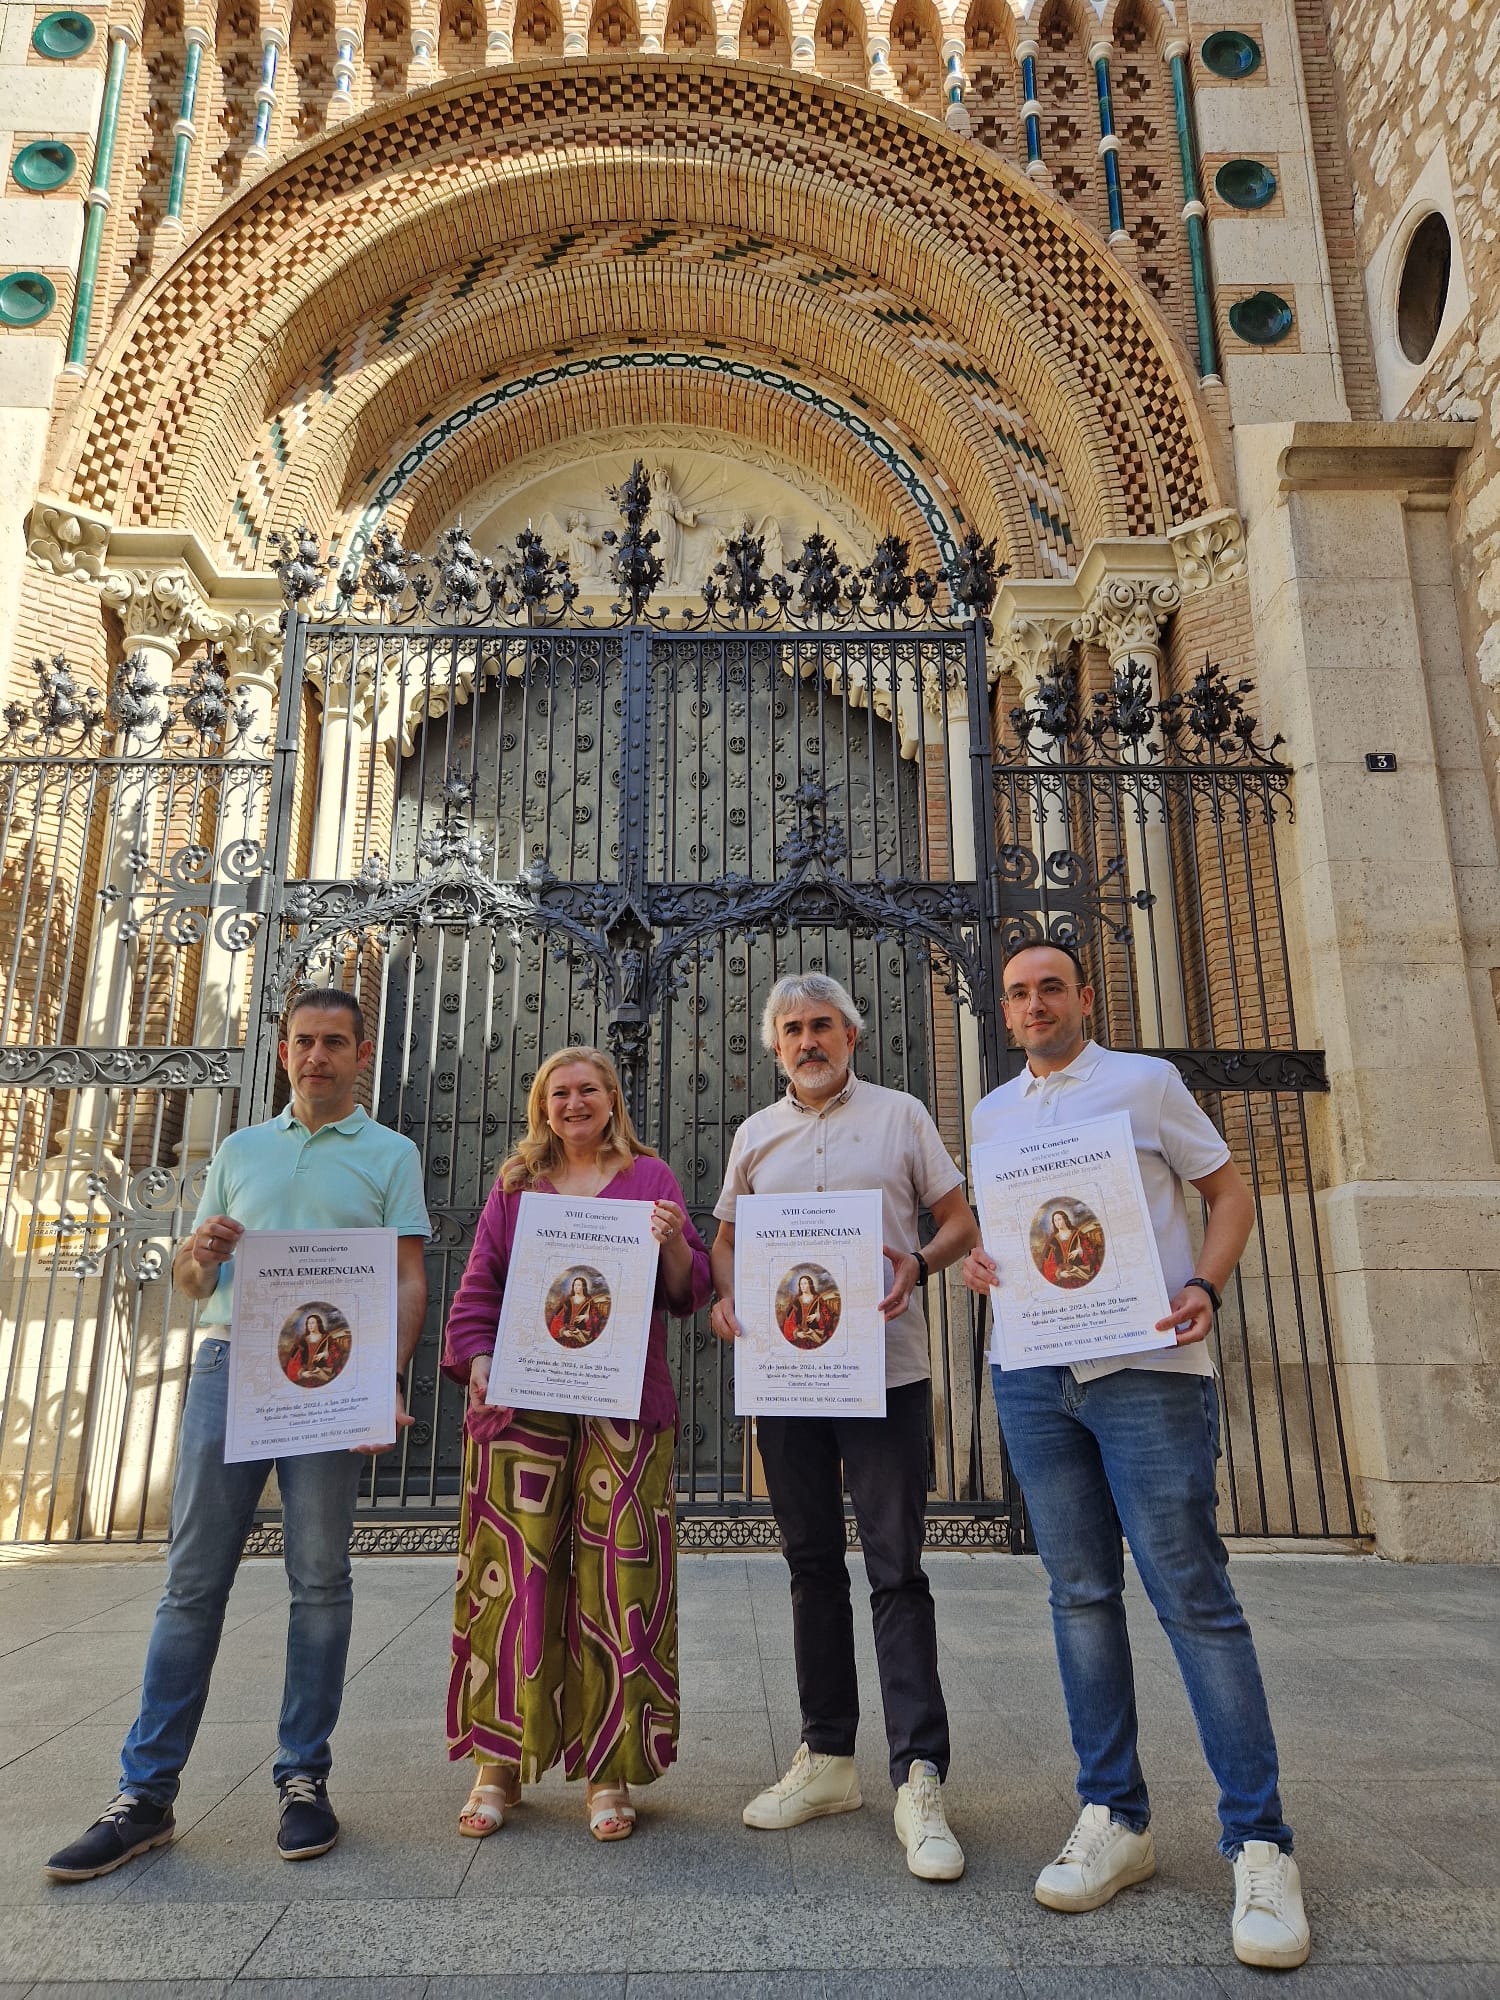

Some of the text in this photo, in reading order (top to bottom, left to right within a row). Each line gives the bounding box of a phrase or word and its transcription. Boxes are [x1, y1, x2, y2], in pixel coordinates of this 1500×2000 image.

[1377, 756, 1388, 768] 3
[1020, 1136, 1079, 1154] XVIII Concierto
[995, 1151, 1112, 1182] SANTA EMERENCIANA
[585, 1213, 618, 1221] Concierto
[536, 1229, 640, 1244] SANTA EMERENCIANA
[756, 1227, 861, 1238] SANTA EMERENCIANA
[259, 1266, 375, 1277] SANTA EMERENCIANA
